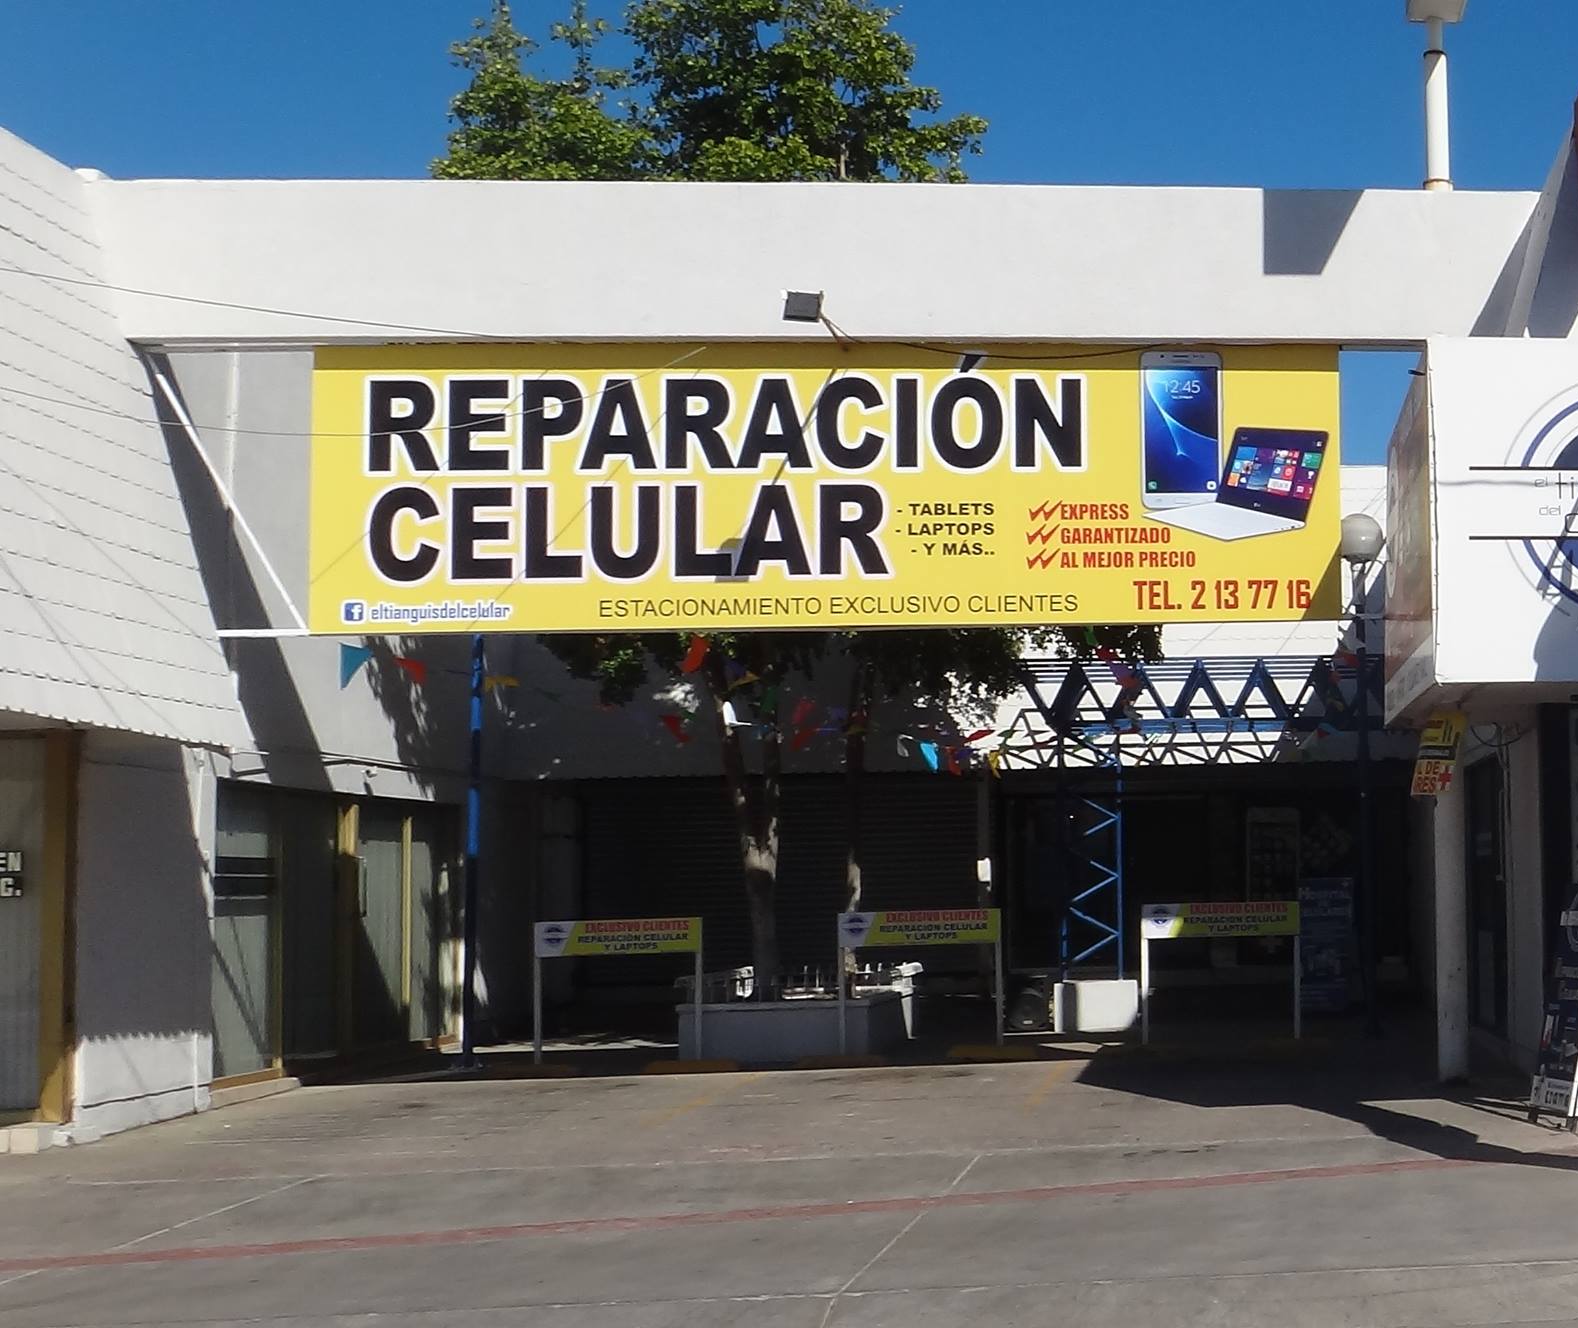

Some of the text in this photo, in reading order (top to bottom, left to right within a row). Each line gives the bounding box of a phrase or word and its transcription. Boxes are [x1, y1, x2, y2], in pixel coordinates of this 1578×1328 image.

[366, 354, 1084, 472] REPARACIÓN
[1534, 476, 1548, 488] el
[908, 502, 995, 517] TABLETS
[1060, 502, 1130, 521] EXPRESS
[1539, 505, 1561, 516] del
[367, 483, 890, 582] CELULAR
[907, 522, 996, 537] LAPTOPS
[1060, 526, 1171, 545] GARANTIZADO
[923, 542, 936, 556] Y
[1060, 550, 1196, 569] AL MEJOR PRECIO
[1133, 579, 1312, 611] TEL. 2 13 77 16
[371, 600, 511, 623] eltianguisdelcelular
[599, 594, 1078, 618] ESTACIONAMIENTO EXCLUSIVO CLIENTES
[585, 919, 690, 933] EXCLUSIVO CLIENTES
[943, 922, 988, 932] CELULAR
[643, 932, 689, 942] CELULAR
